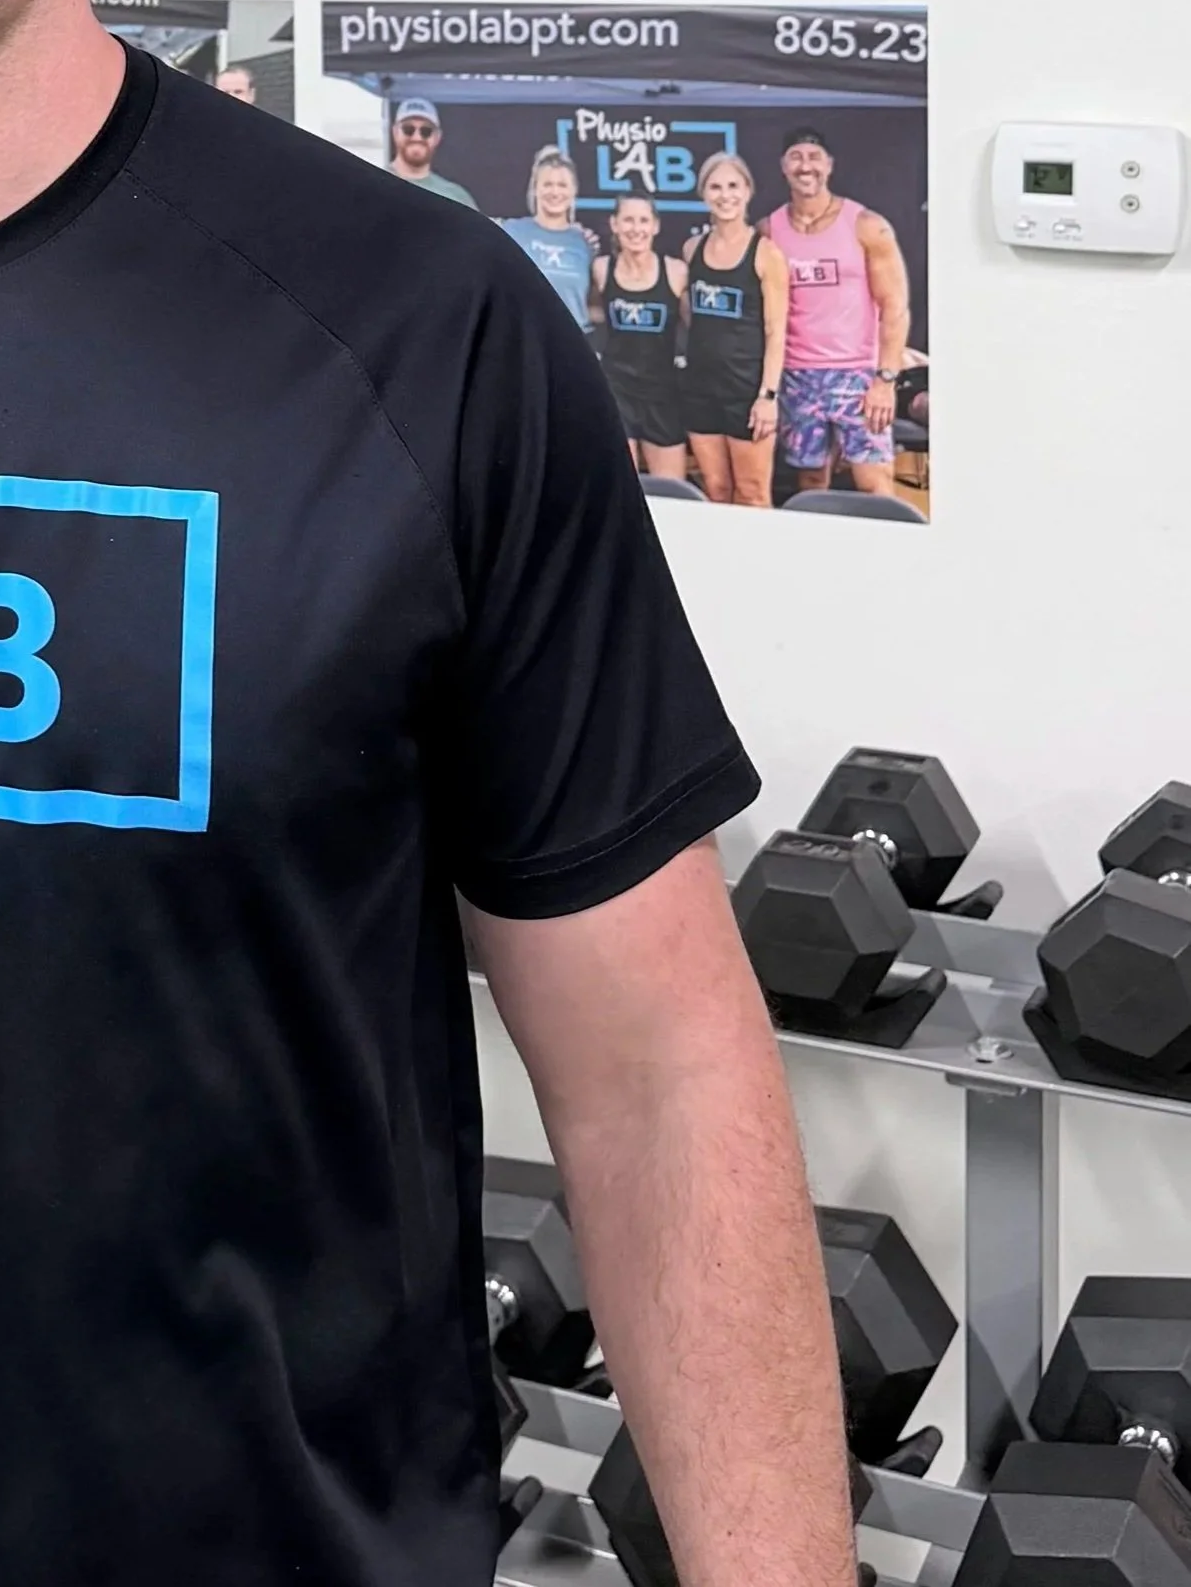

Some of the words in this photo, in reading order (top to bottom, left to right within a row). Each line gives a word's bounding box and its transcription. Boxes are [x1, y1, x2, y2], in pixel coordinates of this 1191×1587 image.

[340, 6, 679, 56] physiolabpt.com
[773, 15, 928, 63] 865.23
[575, 108, 667, 152] Physio
[596, 141, 696, 193] LAB
